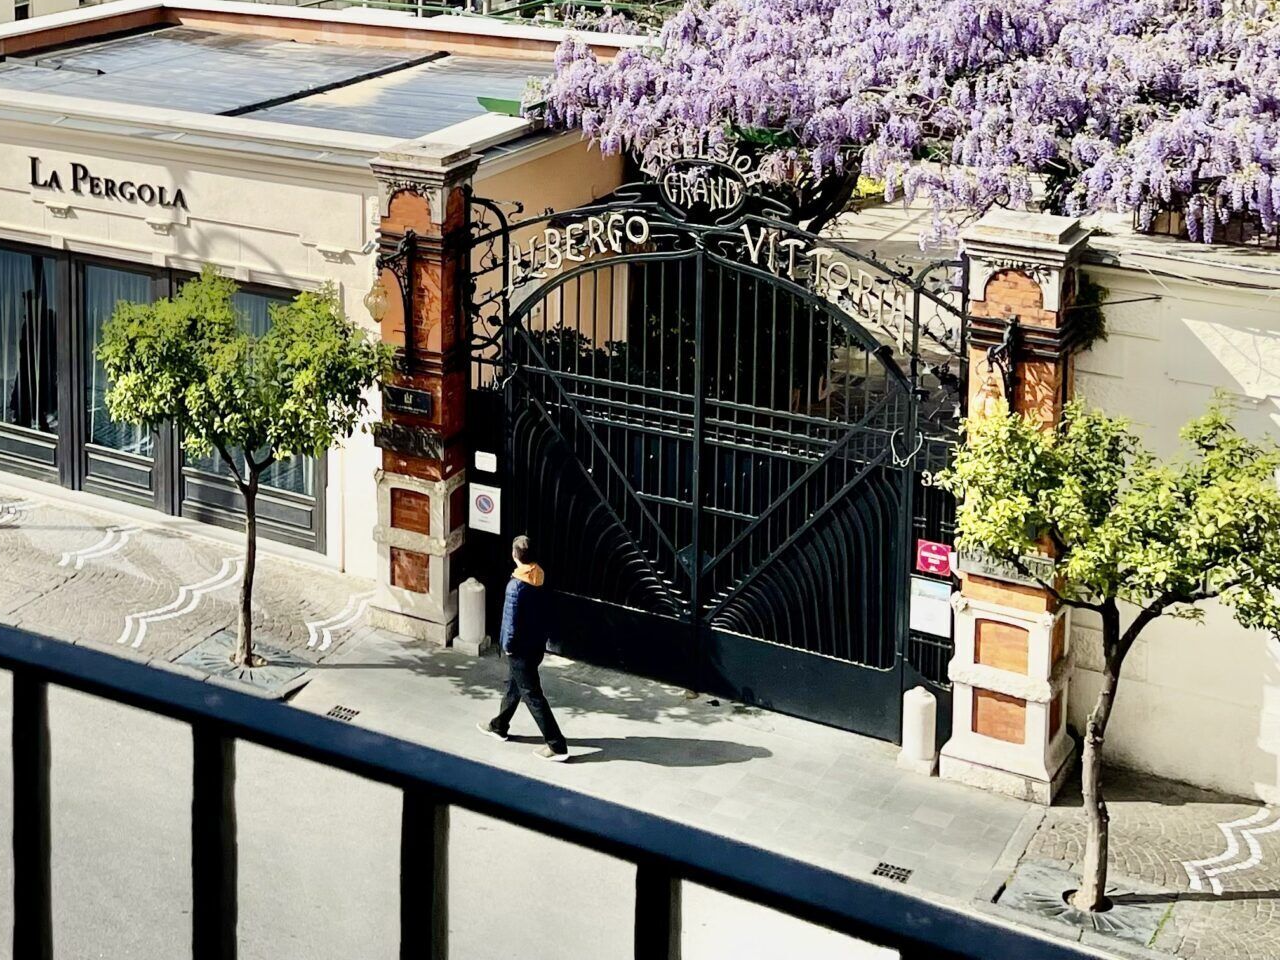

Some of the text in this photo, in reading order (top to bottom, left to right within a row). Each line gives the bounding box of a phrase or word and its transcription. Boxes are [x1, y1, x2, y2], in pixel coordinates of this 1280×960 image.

[28, 156, 188, 210] LA PERGOLA
[640, 138, 766, 188] EXCELSIOR
[664, 171, 742, 212] GRAND
[505, 212, 650, 299] ALBERGO
[740, 224, 908, 356] VITTORIA
